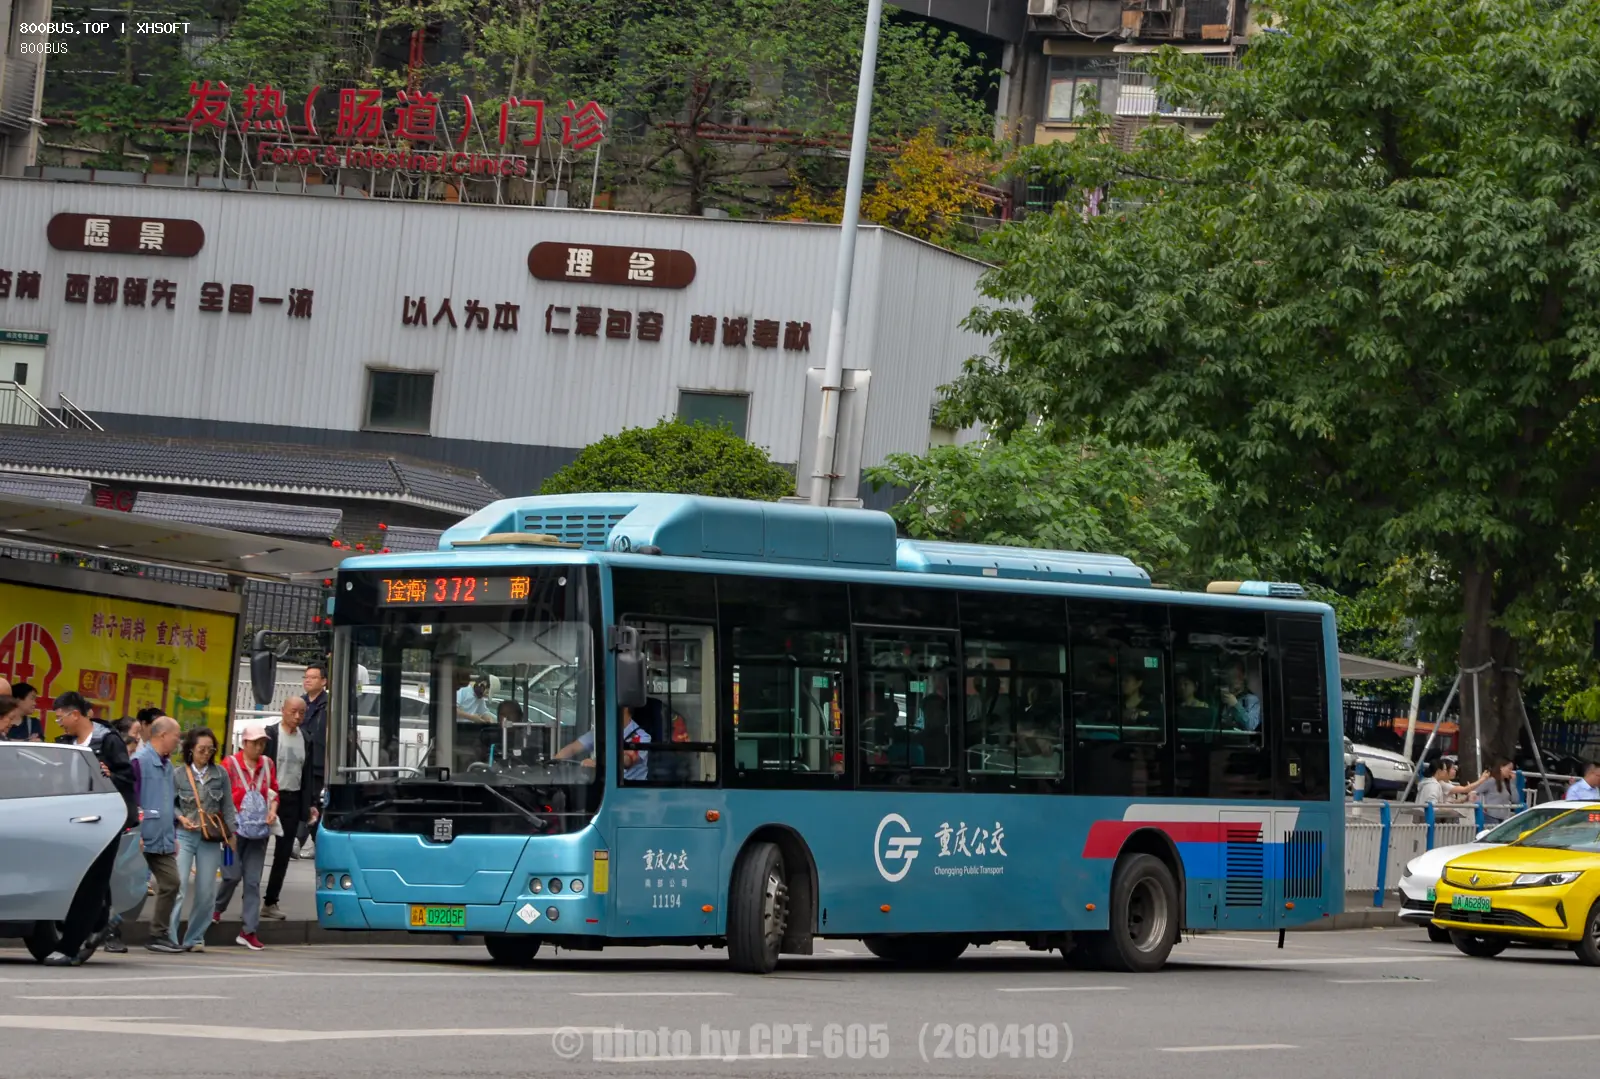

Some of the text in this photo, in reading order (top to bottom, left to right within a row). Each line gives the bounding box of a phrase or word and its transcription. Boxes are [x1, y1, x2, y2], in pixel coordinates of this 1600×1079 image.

[186, 80, 608, 150] 发热（肠道）门诊
[258, 141, 527, 176] Fever & Intestinal Clinics
[84, 218, 165, 250] 愿景
[566, 248, 655, 281] 理念
[65, 273, 177, 309] 西部领先
[199, 281, 314, 318] 全国一流
[402, 296, 811, 352] 以人为本 仁爱包容 精诚奉献
[433, 576, 476, 602] 372
[91, 612, 208, 652] 胖子调料 重庆味道
[934, 821, 1008, 857] 重庆公交
[642, 849, 690, 871] 重庆公交
[934, 866, 1004, 876] Chongqing Public Transport
[520, 909, 537, 918] CNG
[652, 894, 682, 909] 11194
